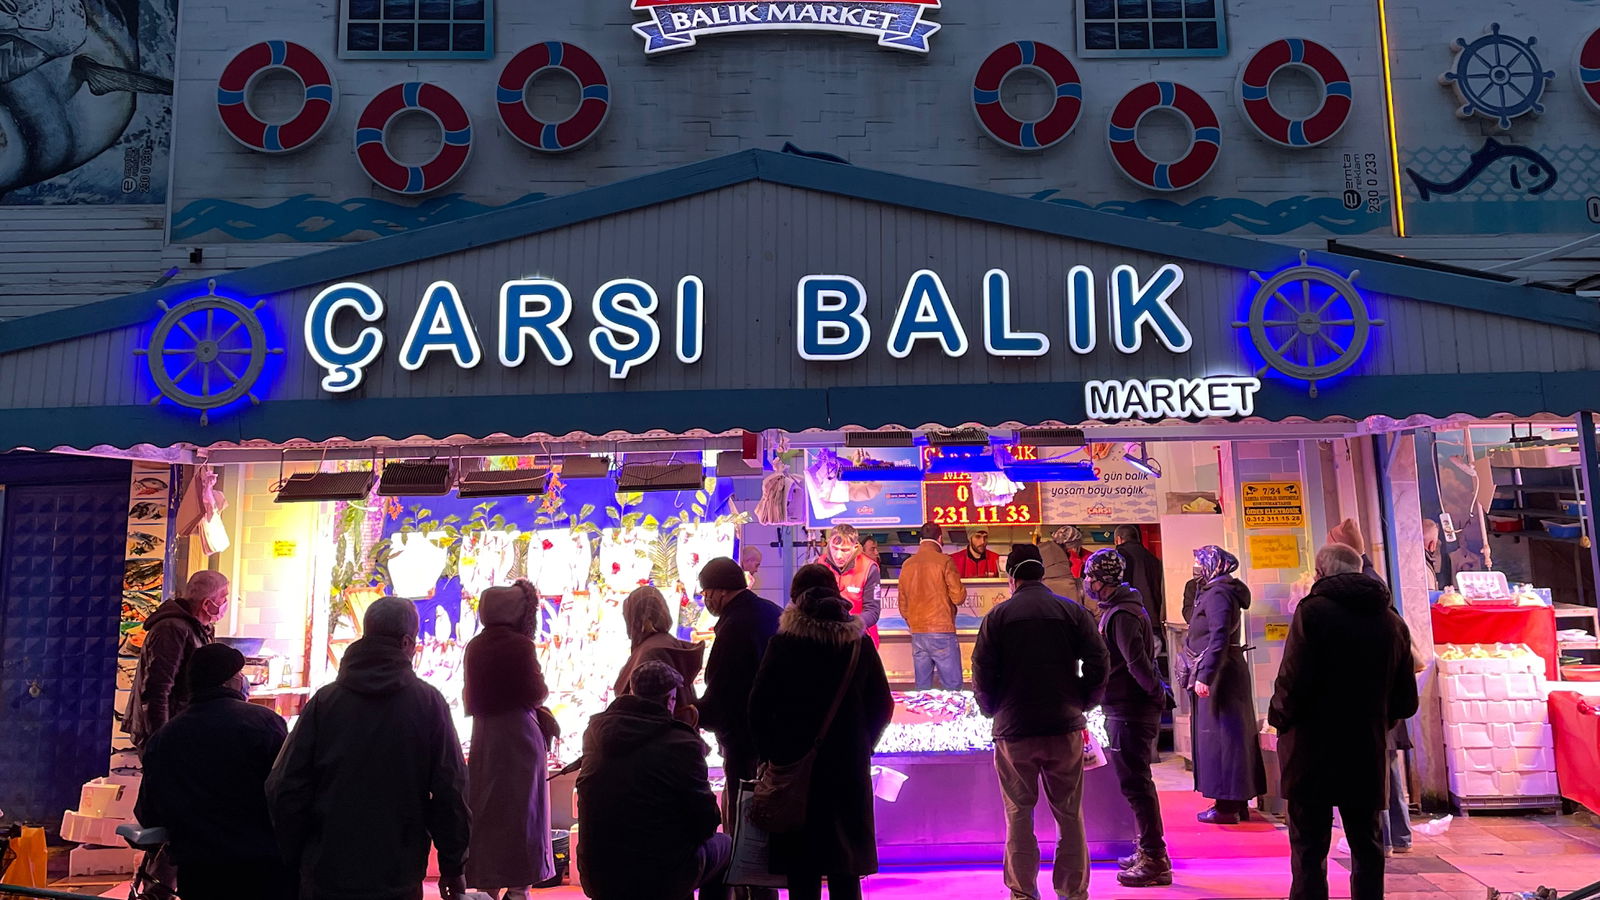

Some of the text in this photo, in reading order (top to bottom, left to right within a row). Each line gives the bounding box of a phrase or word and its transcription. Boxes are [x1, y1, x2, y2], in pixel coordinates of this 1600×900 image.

[672, 4, 902, 31] BALIK MARKET
[1364, 153, 1377, 175] 233
[1368, 190, 1380, 212] 230
[304, 263, 1193, 393] ÇARŞI BALIK
[1086, 378, 1261, 418] MARKET
[1103, 472, 1122, 482] gün
[1125, 471, 1149, 480] balık
[956, 485, 969, 502] 0
[1051, 485, 1144, 497] yaşam boyu sağlık
[1262, 487, 1281, 495] 7/24
[933, 505, 1030, 523] 231 11 33
